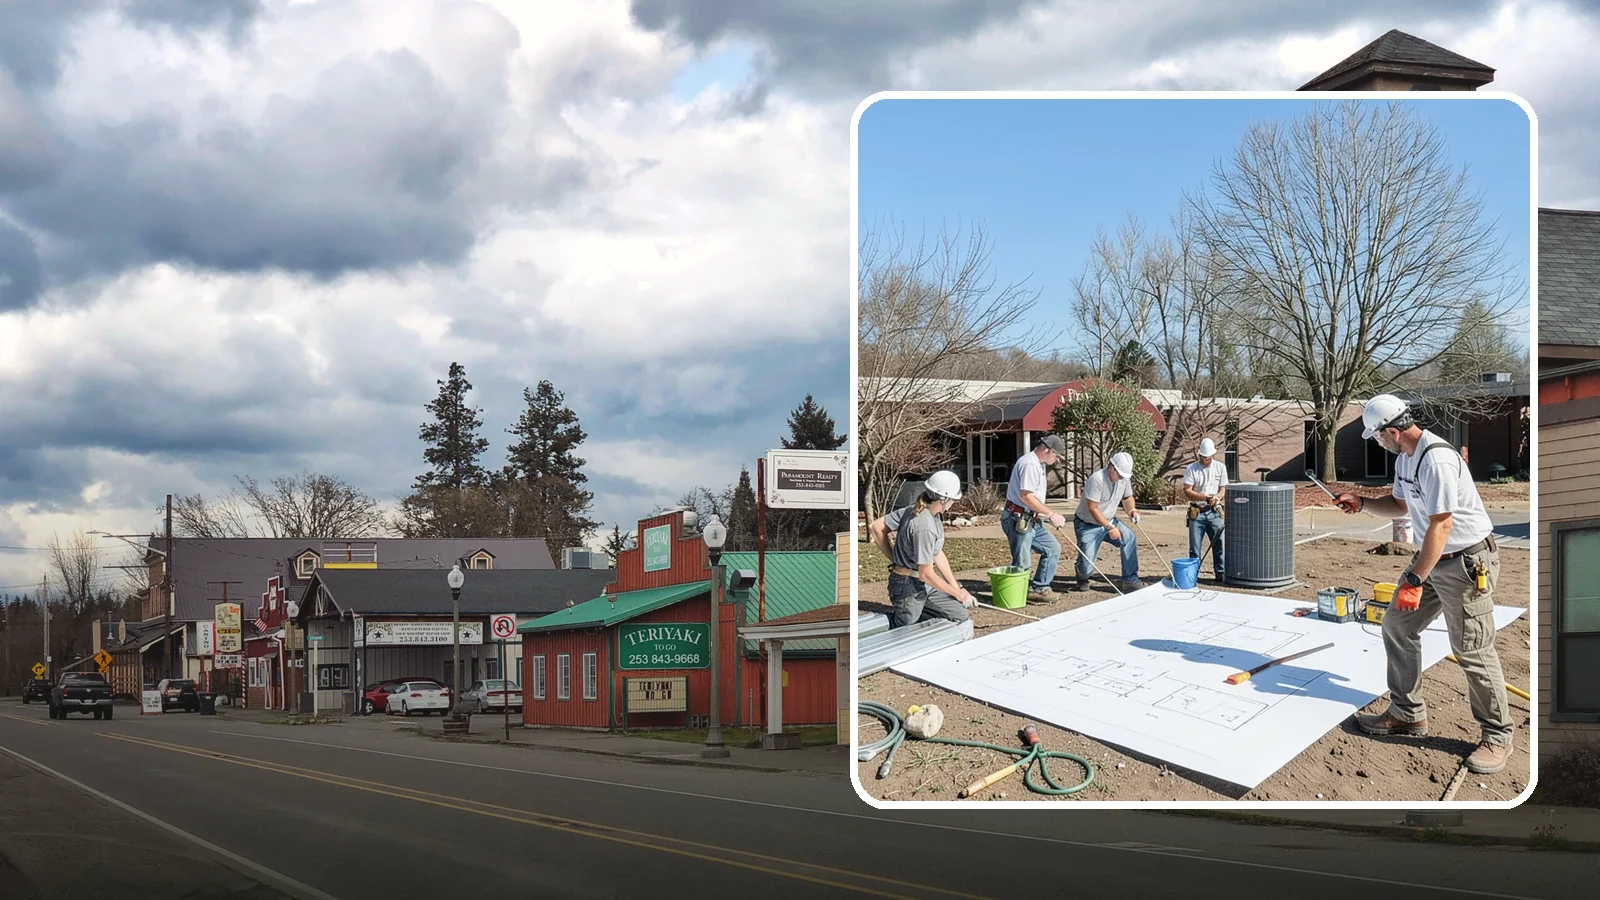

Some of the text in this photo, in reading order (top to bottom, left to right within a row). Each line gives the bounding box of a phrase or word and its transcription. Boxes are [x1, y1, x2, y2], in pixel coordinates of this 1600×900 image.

[624, 627, 702, 646] TERIYAKI
[665, 643, 677, 651] GO
[629, 653, 700, 665] 253 843-9668
